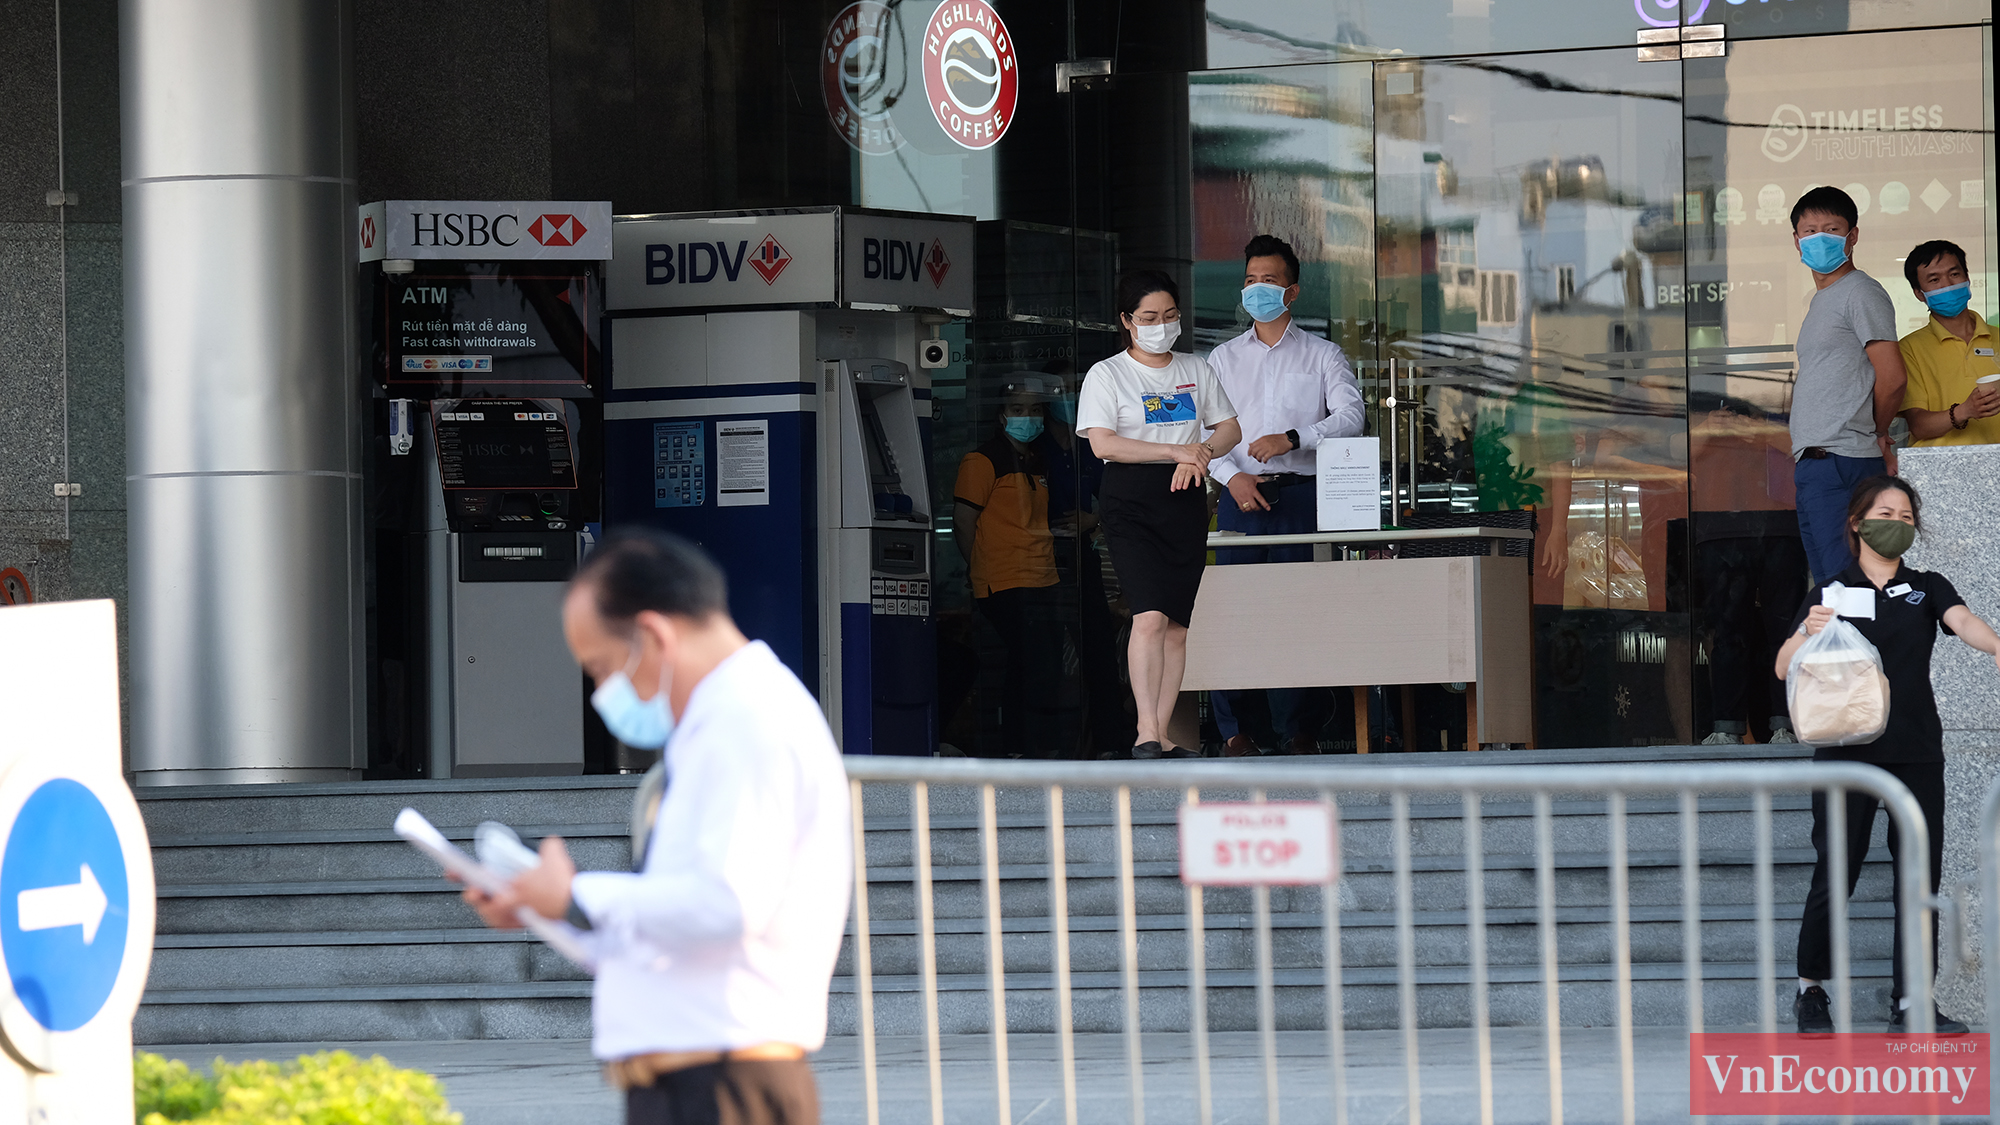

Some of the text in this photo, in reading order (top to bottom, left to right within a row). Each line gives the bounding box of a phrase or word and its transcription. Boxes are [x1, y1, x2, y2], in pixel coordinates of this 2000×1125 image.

[928, 3, 1013, 71] HIGHLANDS
[939, 100, 1005, 140] COFFEE
[1811, 104, 1943, 135] TIMELESS
[1812, 129, 1974, 161] TRUTH MASK
[411, 213, 519, 248] HSBC
[645, 240, 749, 286] BIDV
[864, 237, 925, 283] BIDV
[401, 287, 447, 304] ATM
[1657, 283, 1701, 304] BEST
[1030, 304, 1073, 317] Hours
[402, 317, 527, 334] Rút tiền mặt dễ dàng
[402, 336, 537, 347] Fast cash withdrawals
[1036, 346, 1074, 359] 21.00
[468, 443, 511, 457] HSBC
[1616, 630, 1637, 663] NHA
[1213, 839, 1302, 867] STOP
